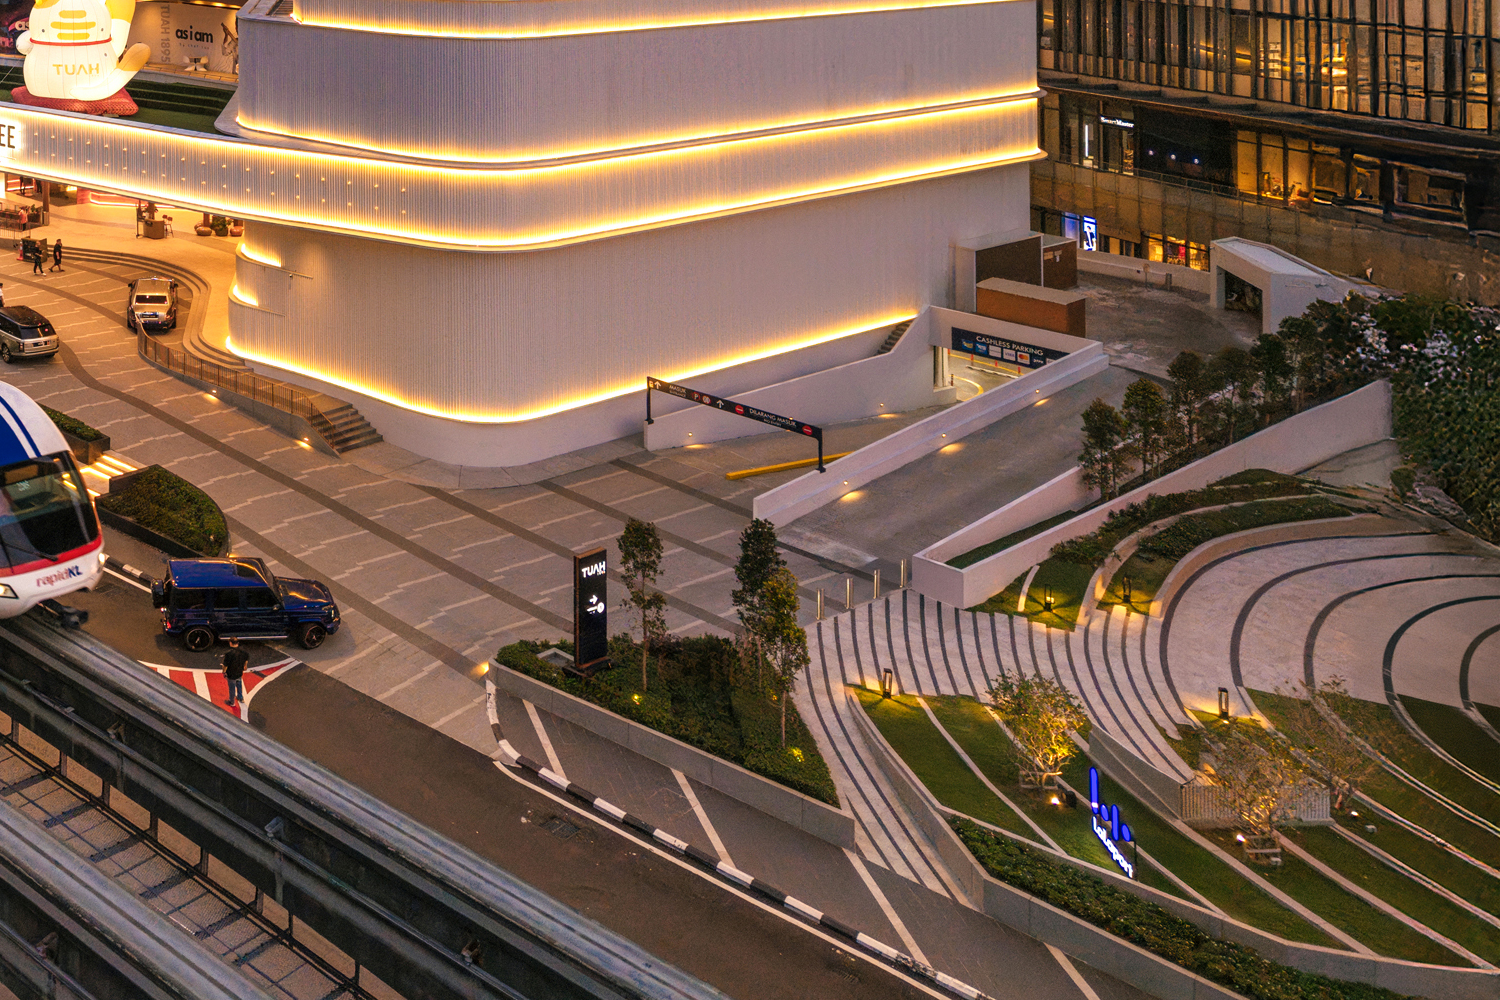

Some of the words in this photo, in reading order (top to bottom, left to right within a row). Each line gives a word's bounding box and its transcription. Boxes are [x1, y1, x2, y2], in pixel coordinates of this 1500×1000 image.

[52, 63, 99, 75] TUAH
[975, 335, 1011, 349] CASHLESS
[1011, 343, 1044, 356] PARKING
[36, 564, 83, 588] rapidKL
[581, 560, 606, 579] TUAH
[1091, 815, 1134, 879] LaLaport
